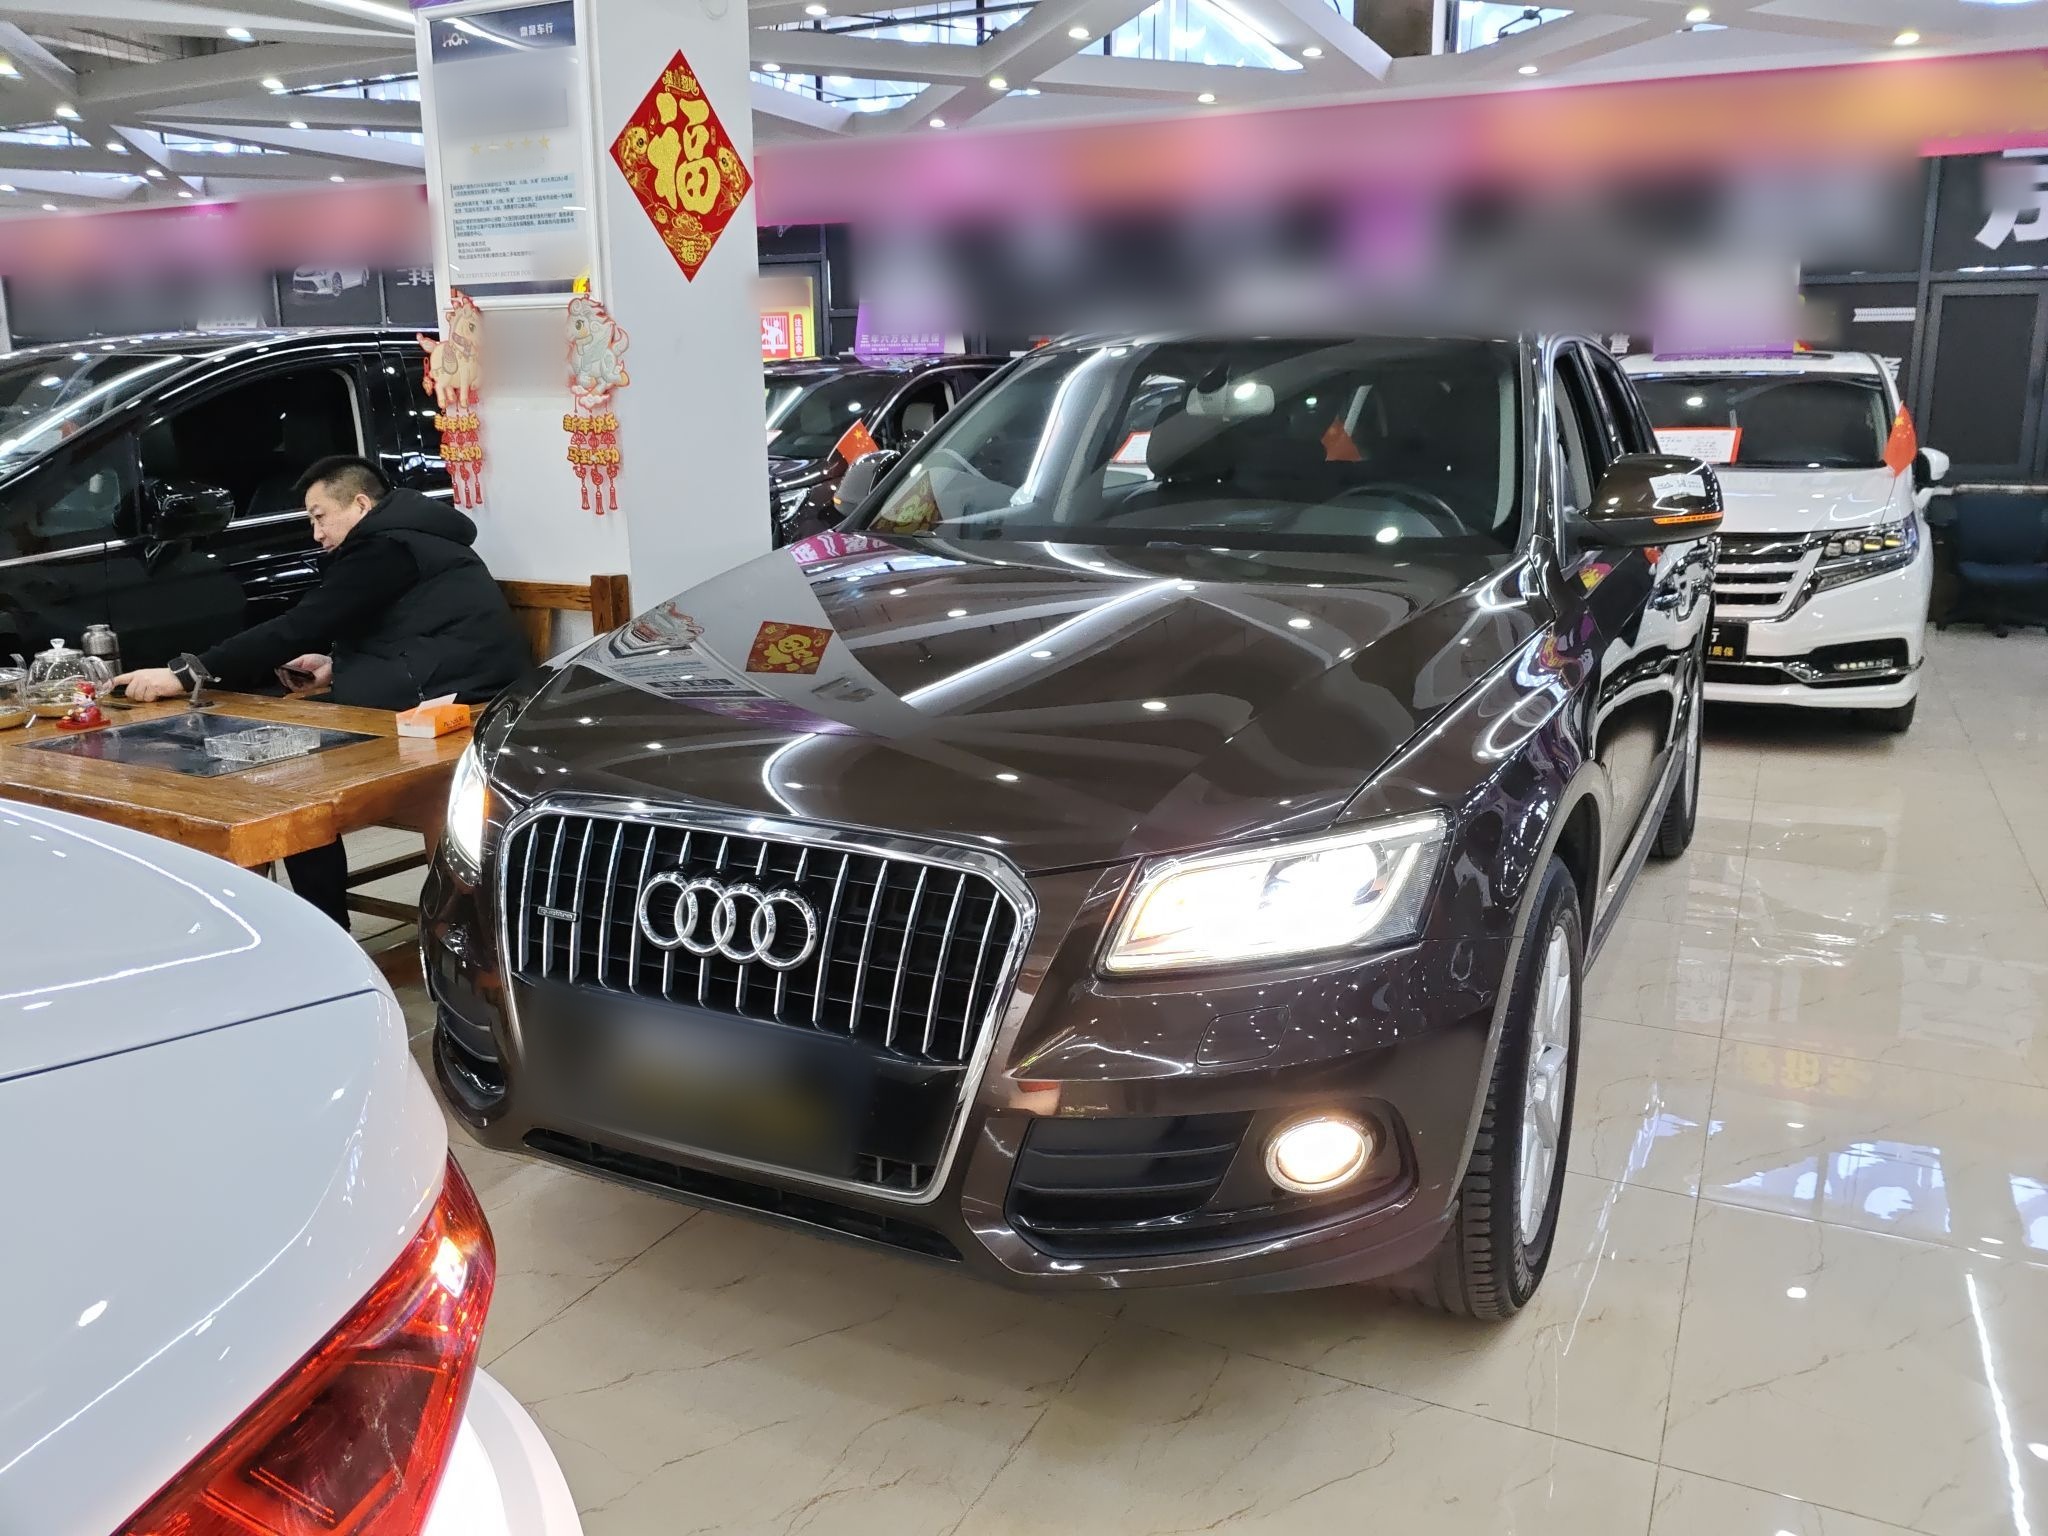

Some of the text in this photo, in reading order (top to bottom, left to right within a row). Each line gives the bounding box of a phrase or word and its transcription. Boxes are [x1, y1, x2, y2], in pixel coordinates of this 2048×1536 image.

[647, 93, 721, 214] 福
[793, 317, 803, 353] 注意安全
[434, 414, 479, 433] 新年快乐
[563, 413, 619, 435] 新年快乐
[439, 444, 482, 463] 马到成功
[567, 446, 621, 465] 马到成功
[1708, 645, 1734, 657] 质保
